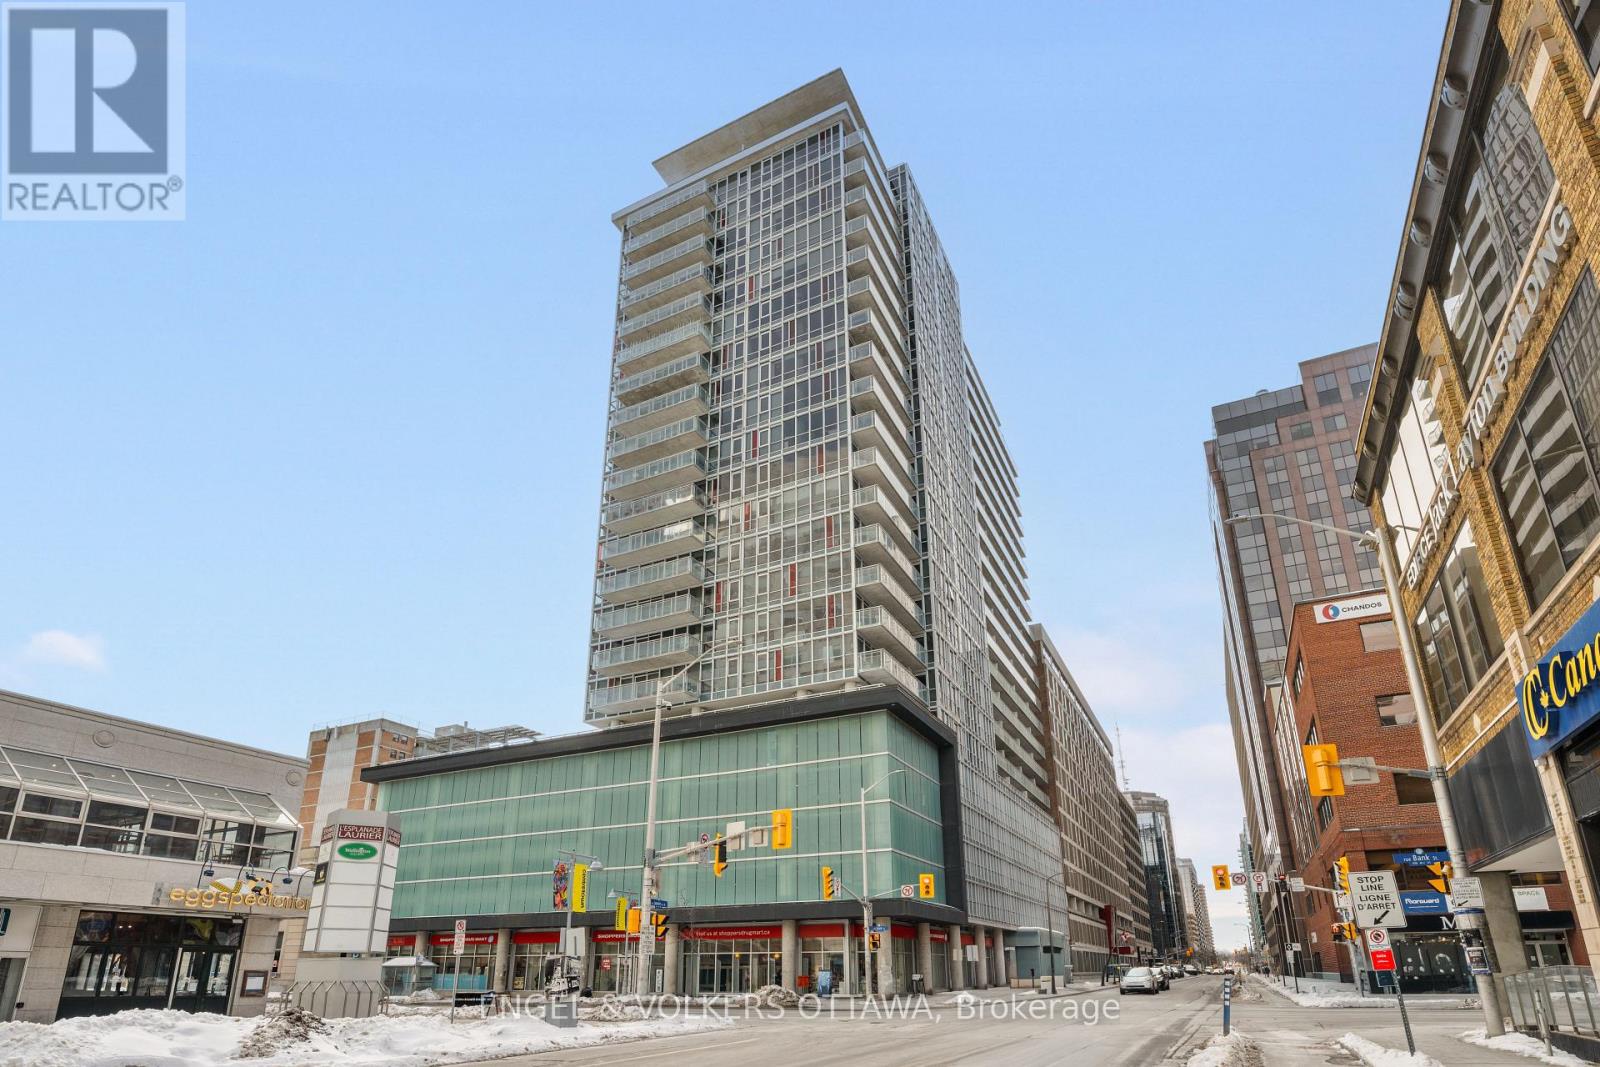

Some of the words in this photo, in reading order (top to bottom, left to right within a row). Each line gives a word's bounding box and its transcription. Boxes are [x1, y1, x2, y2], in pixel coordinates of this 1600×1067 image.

[1428, 474, 1460, 544] Jack
[1448, 375, 1502, 489] Layton
[1494, 204, 1572, 384] BUILDING
[1341, 601, 1382, 613] CHANDOS
[339, 824, 382, 833] L'ESPLANADE
[338, 831, 382, 840] LAURIER
[1356, 875, 1384, 884] STOP
[1360, 883, 1385, 892] LINE
[1359, 894, 1391, 902] LIGNE
[1357, 902, 1396, 911] D'ARRET
